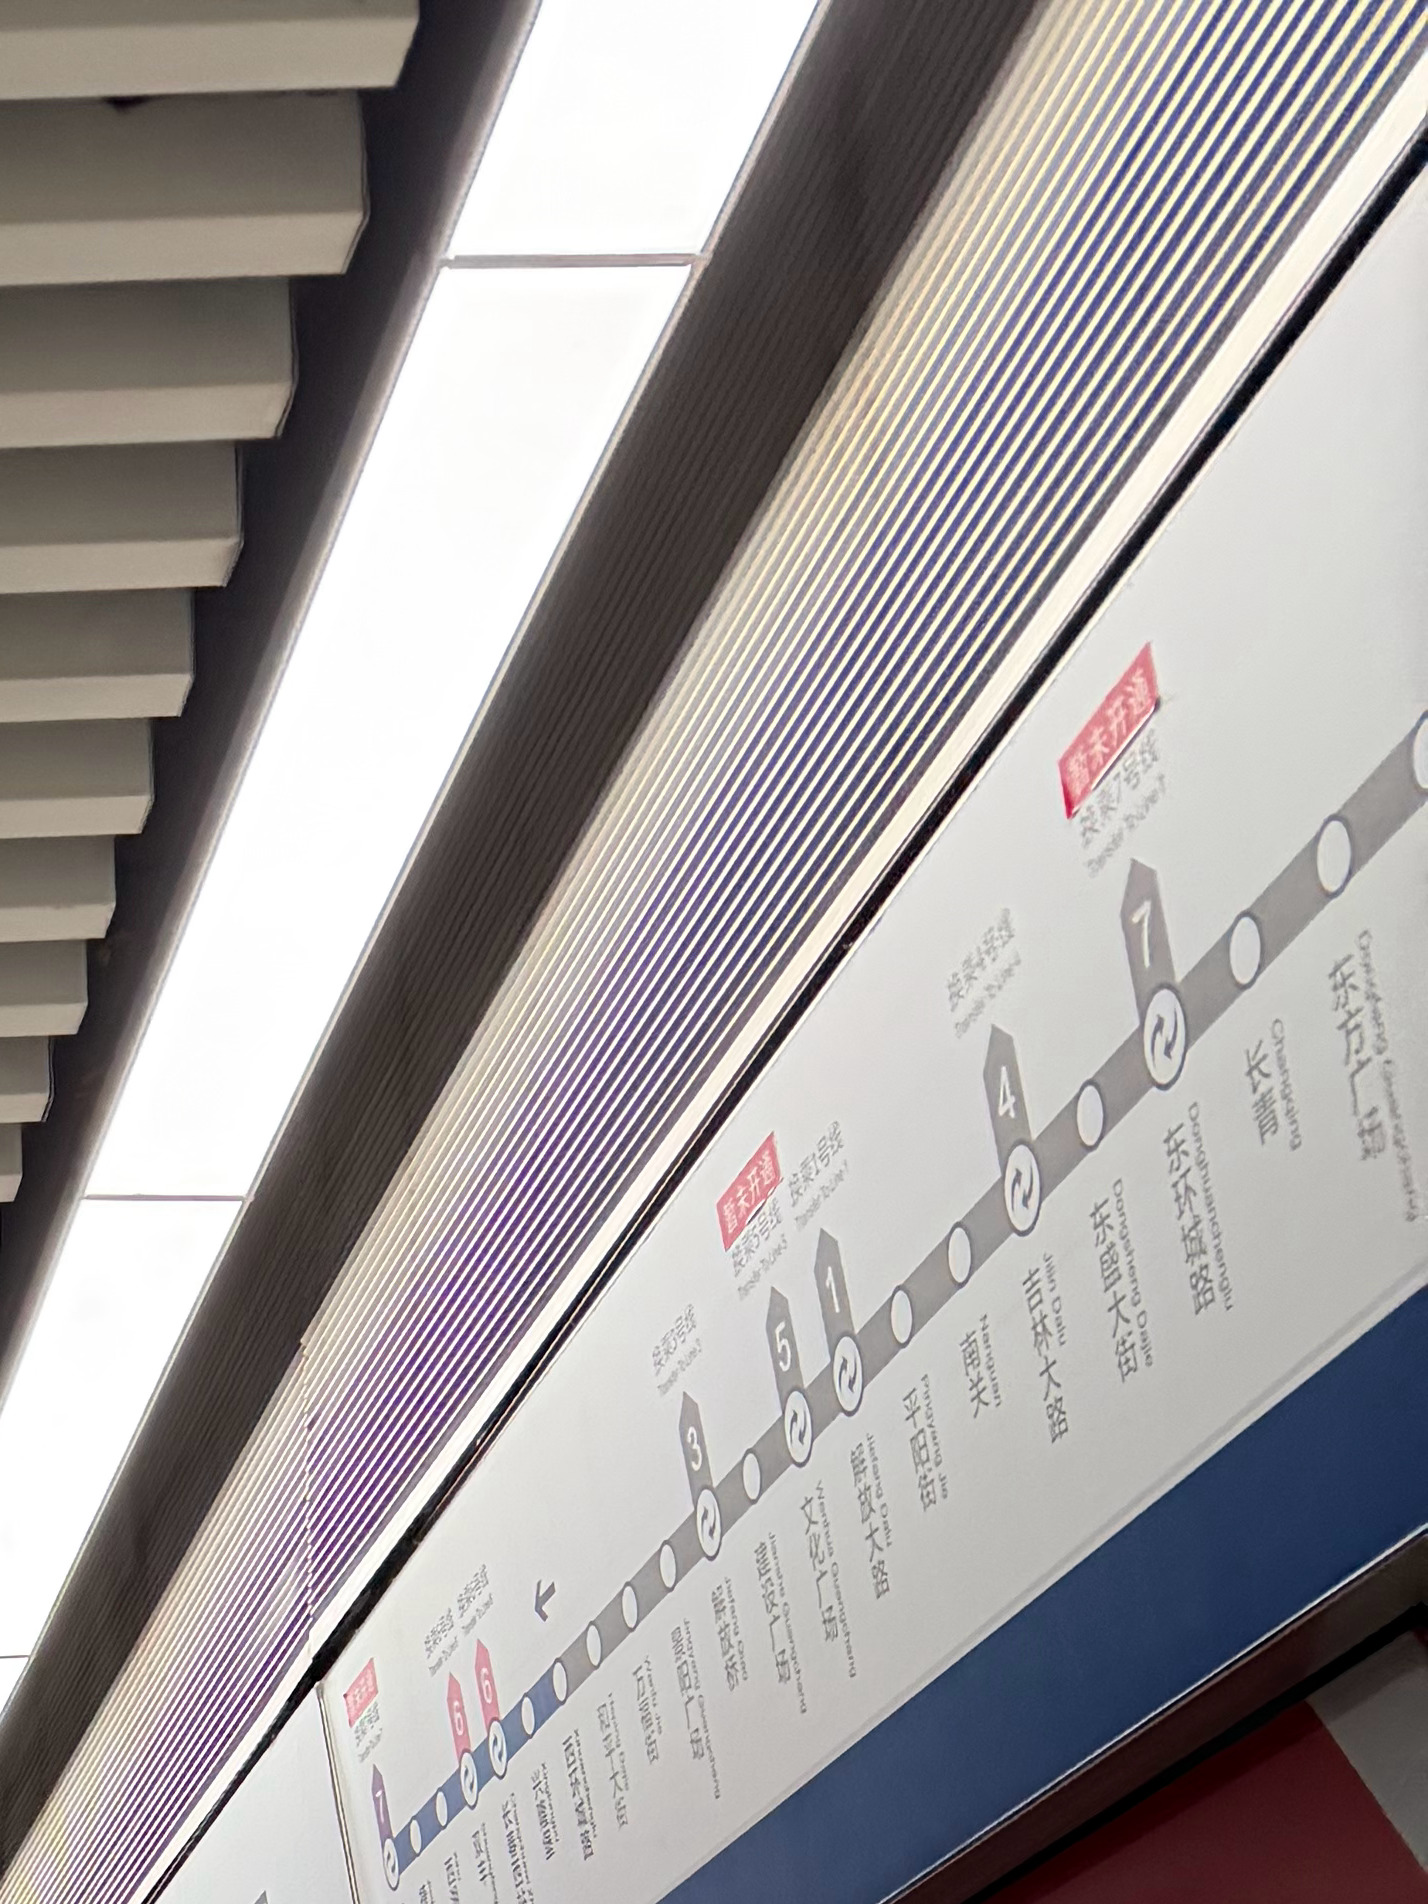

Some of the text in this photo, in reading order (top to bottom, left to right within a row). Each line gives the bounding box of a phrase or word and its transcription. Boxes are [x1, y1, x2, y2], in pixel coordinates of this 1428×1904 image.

[1065, 666, 1150, 794] 暂未开通
[1131, 901, 1150, 967] 7
[997, 1065, 1015, 1119] 4
[1244, 1040, 1283, 1145] 长青
[1271, 1018, 1303, 1152] Changqing
[1329, 954, 1389, 1162] 东方广场
[722, 1150, 780, 1234] 暂未开通
[1163, 1123, 1215, 1316] 东环城路
[1189, 1102, 1234, 1311] Donghuanchenglu
[825, 1266, 840, 1313] 1
[1090, 1200, 1138, 1383] 东盛大街
[774, 1321, 791, 1371] 5
[959, 1330, 990, 1419] 南关
[979, 1314, 1001, 1408] Nanguan
[1022, 1267, 1069, 1443] 吉林大路
[687, 1426, 702, 1472] 3
[903, 1387, 937, 1512] 平阳街
[800, 1495, 838, 1643] 文化广场
[850, 1442, 890, 1600] 解放大路
[711, 1584, 740, 1693] 解放桥
[754, 1542, 791, 1686] 建设广场
[453, 1700, 464, 1736] 6
[481, 1667, 492, 1705] 6
[671, 1626, 704, 1760] 景阳广场
[375, 1789, 385, 1823] 7
